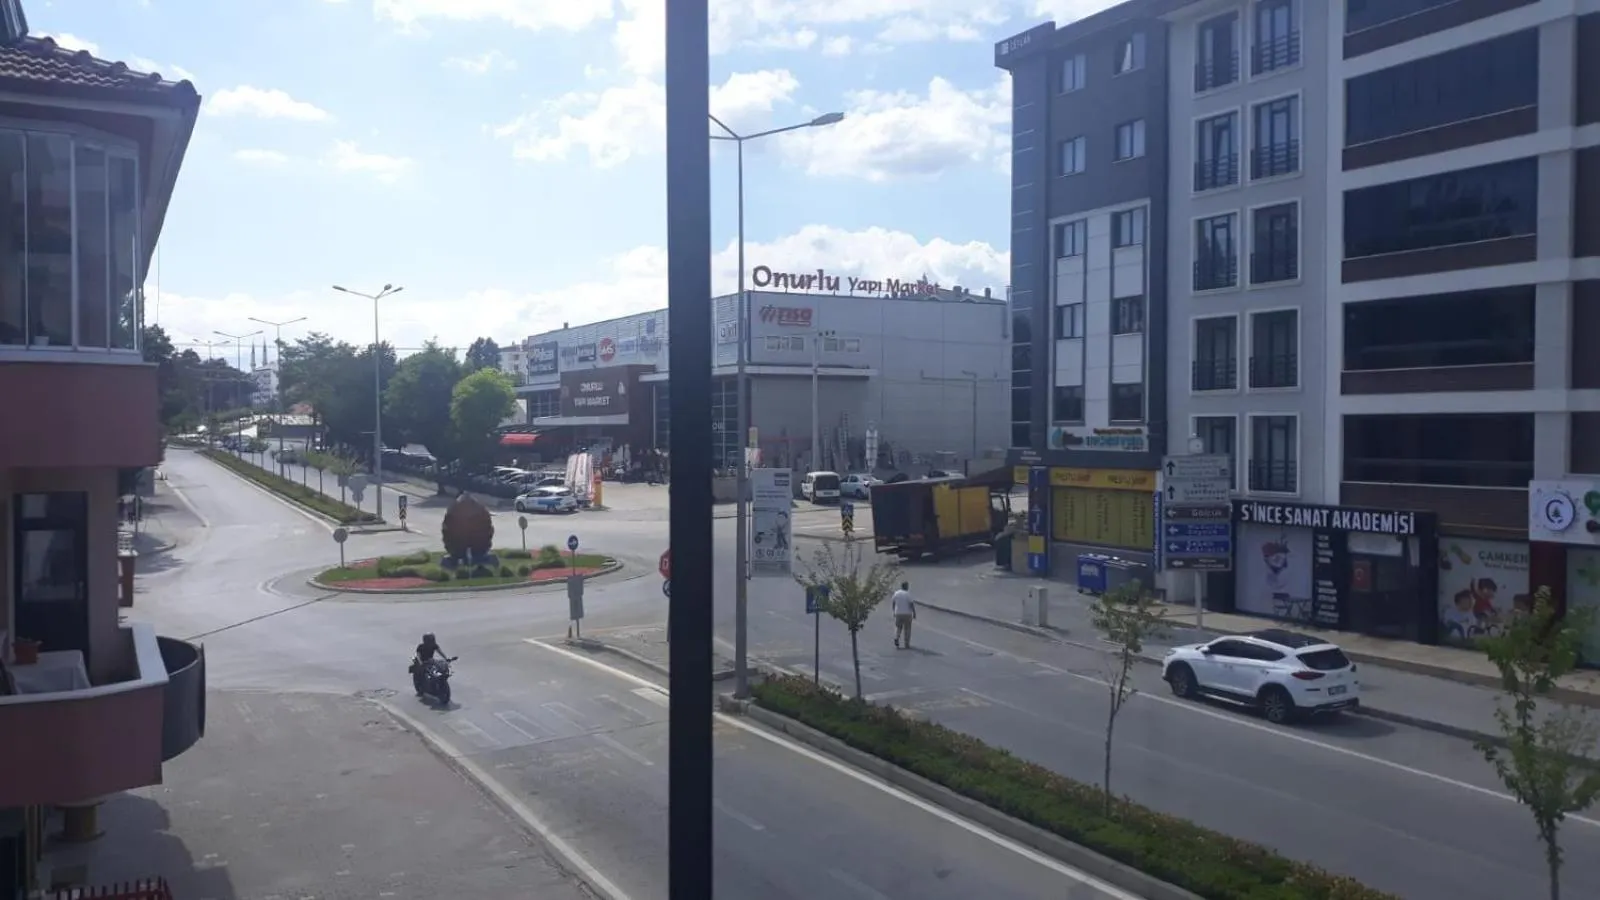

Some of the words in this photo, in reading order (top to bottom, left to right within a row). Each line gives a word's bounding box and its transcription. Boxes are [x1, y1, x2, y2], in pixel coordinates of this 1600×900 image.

[752, 265, 840, 291] Onurlu
[886, 278, 941, 296] Market
[1241, 502, 1282, 524] S'İNCE
[1285, 507, 1330, 529] SANAT
[1332, 511, 1415, 535] AKADEMİSİ
